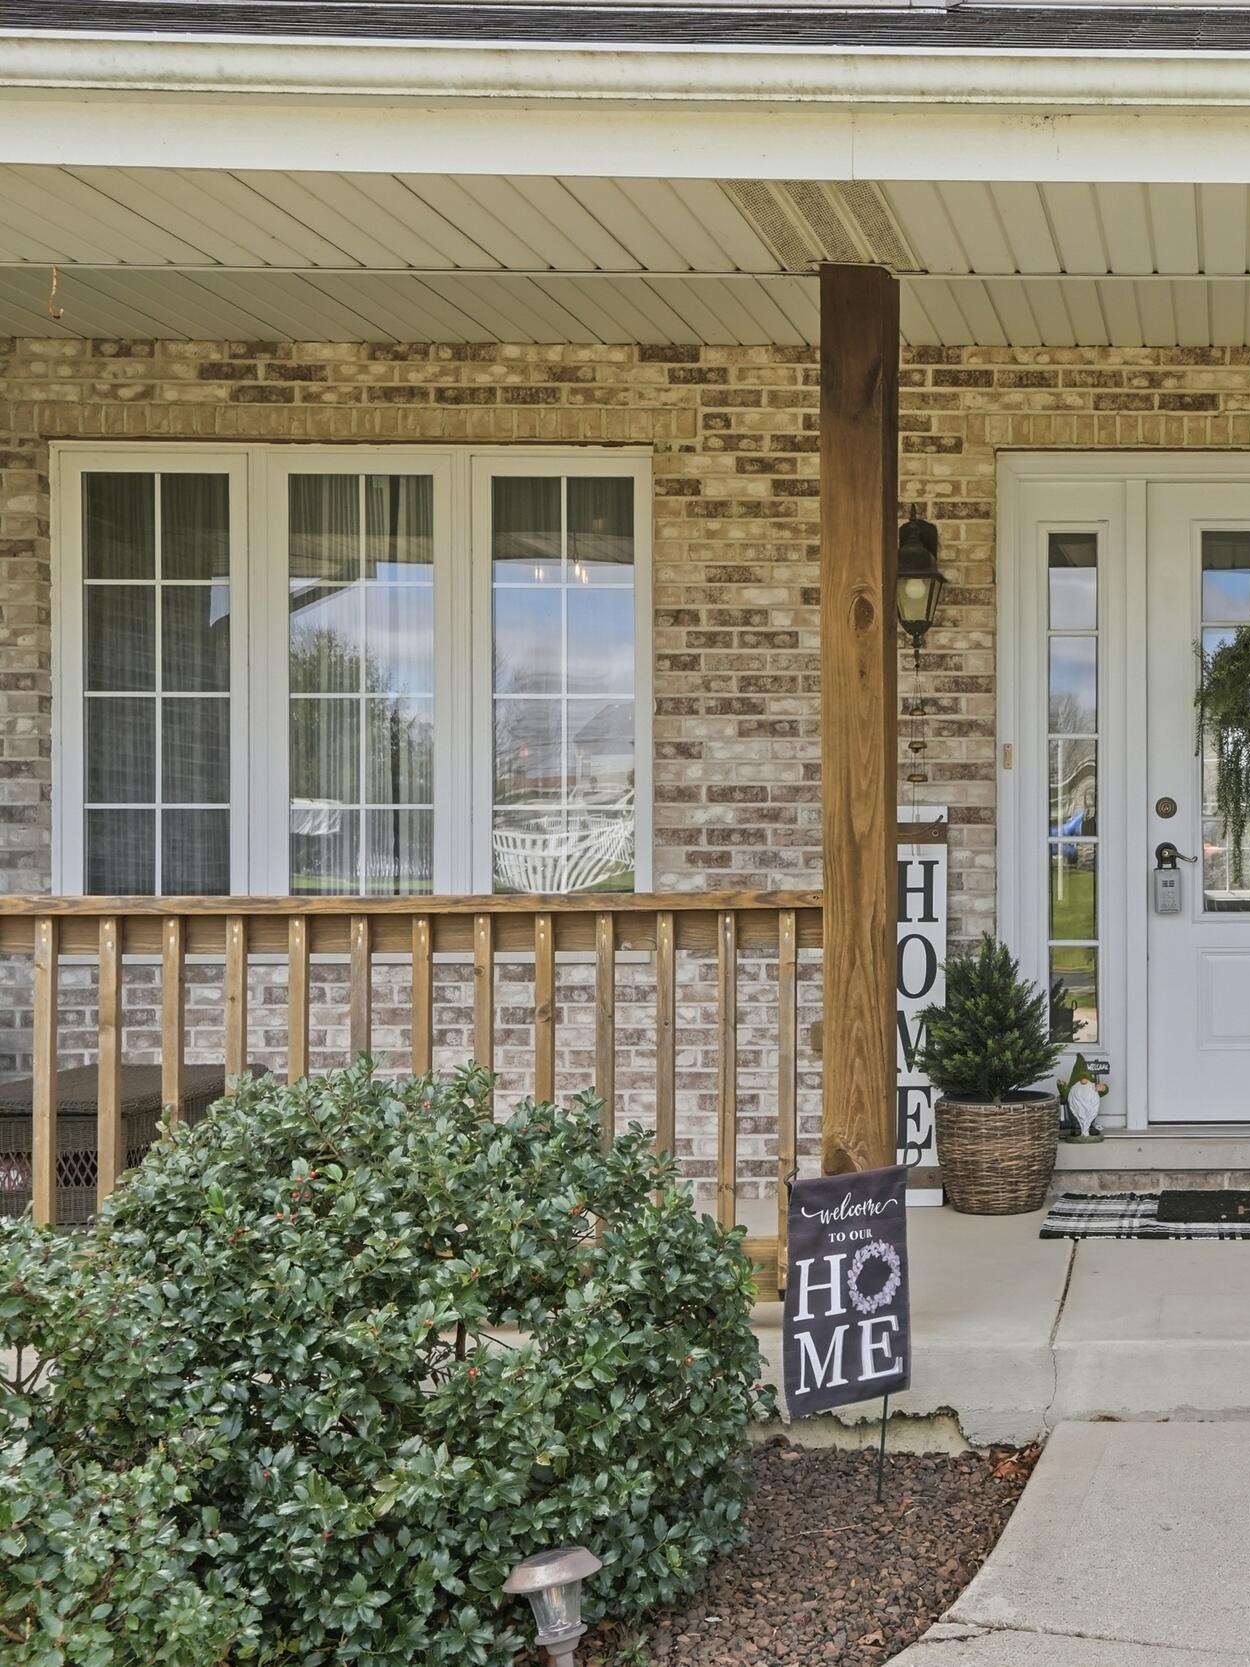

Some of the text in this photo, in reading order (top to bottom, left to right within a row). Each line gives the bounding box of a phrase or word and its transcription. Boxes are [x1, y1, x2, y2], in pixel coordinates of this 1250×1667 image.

[801, 1191, 898, 1225] welcome
[828, 1228, 873, 1242] TO OUR
